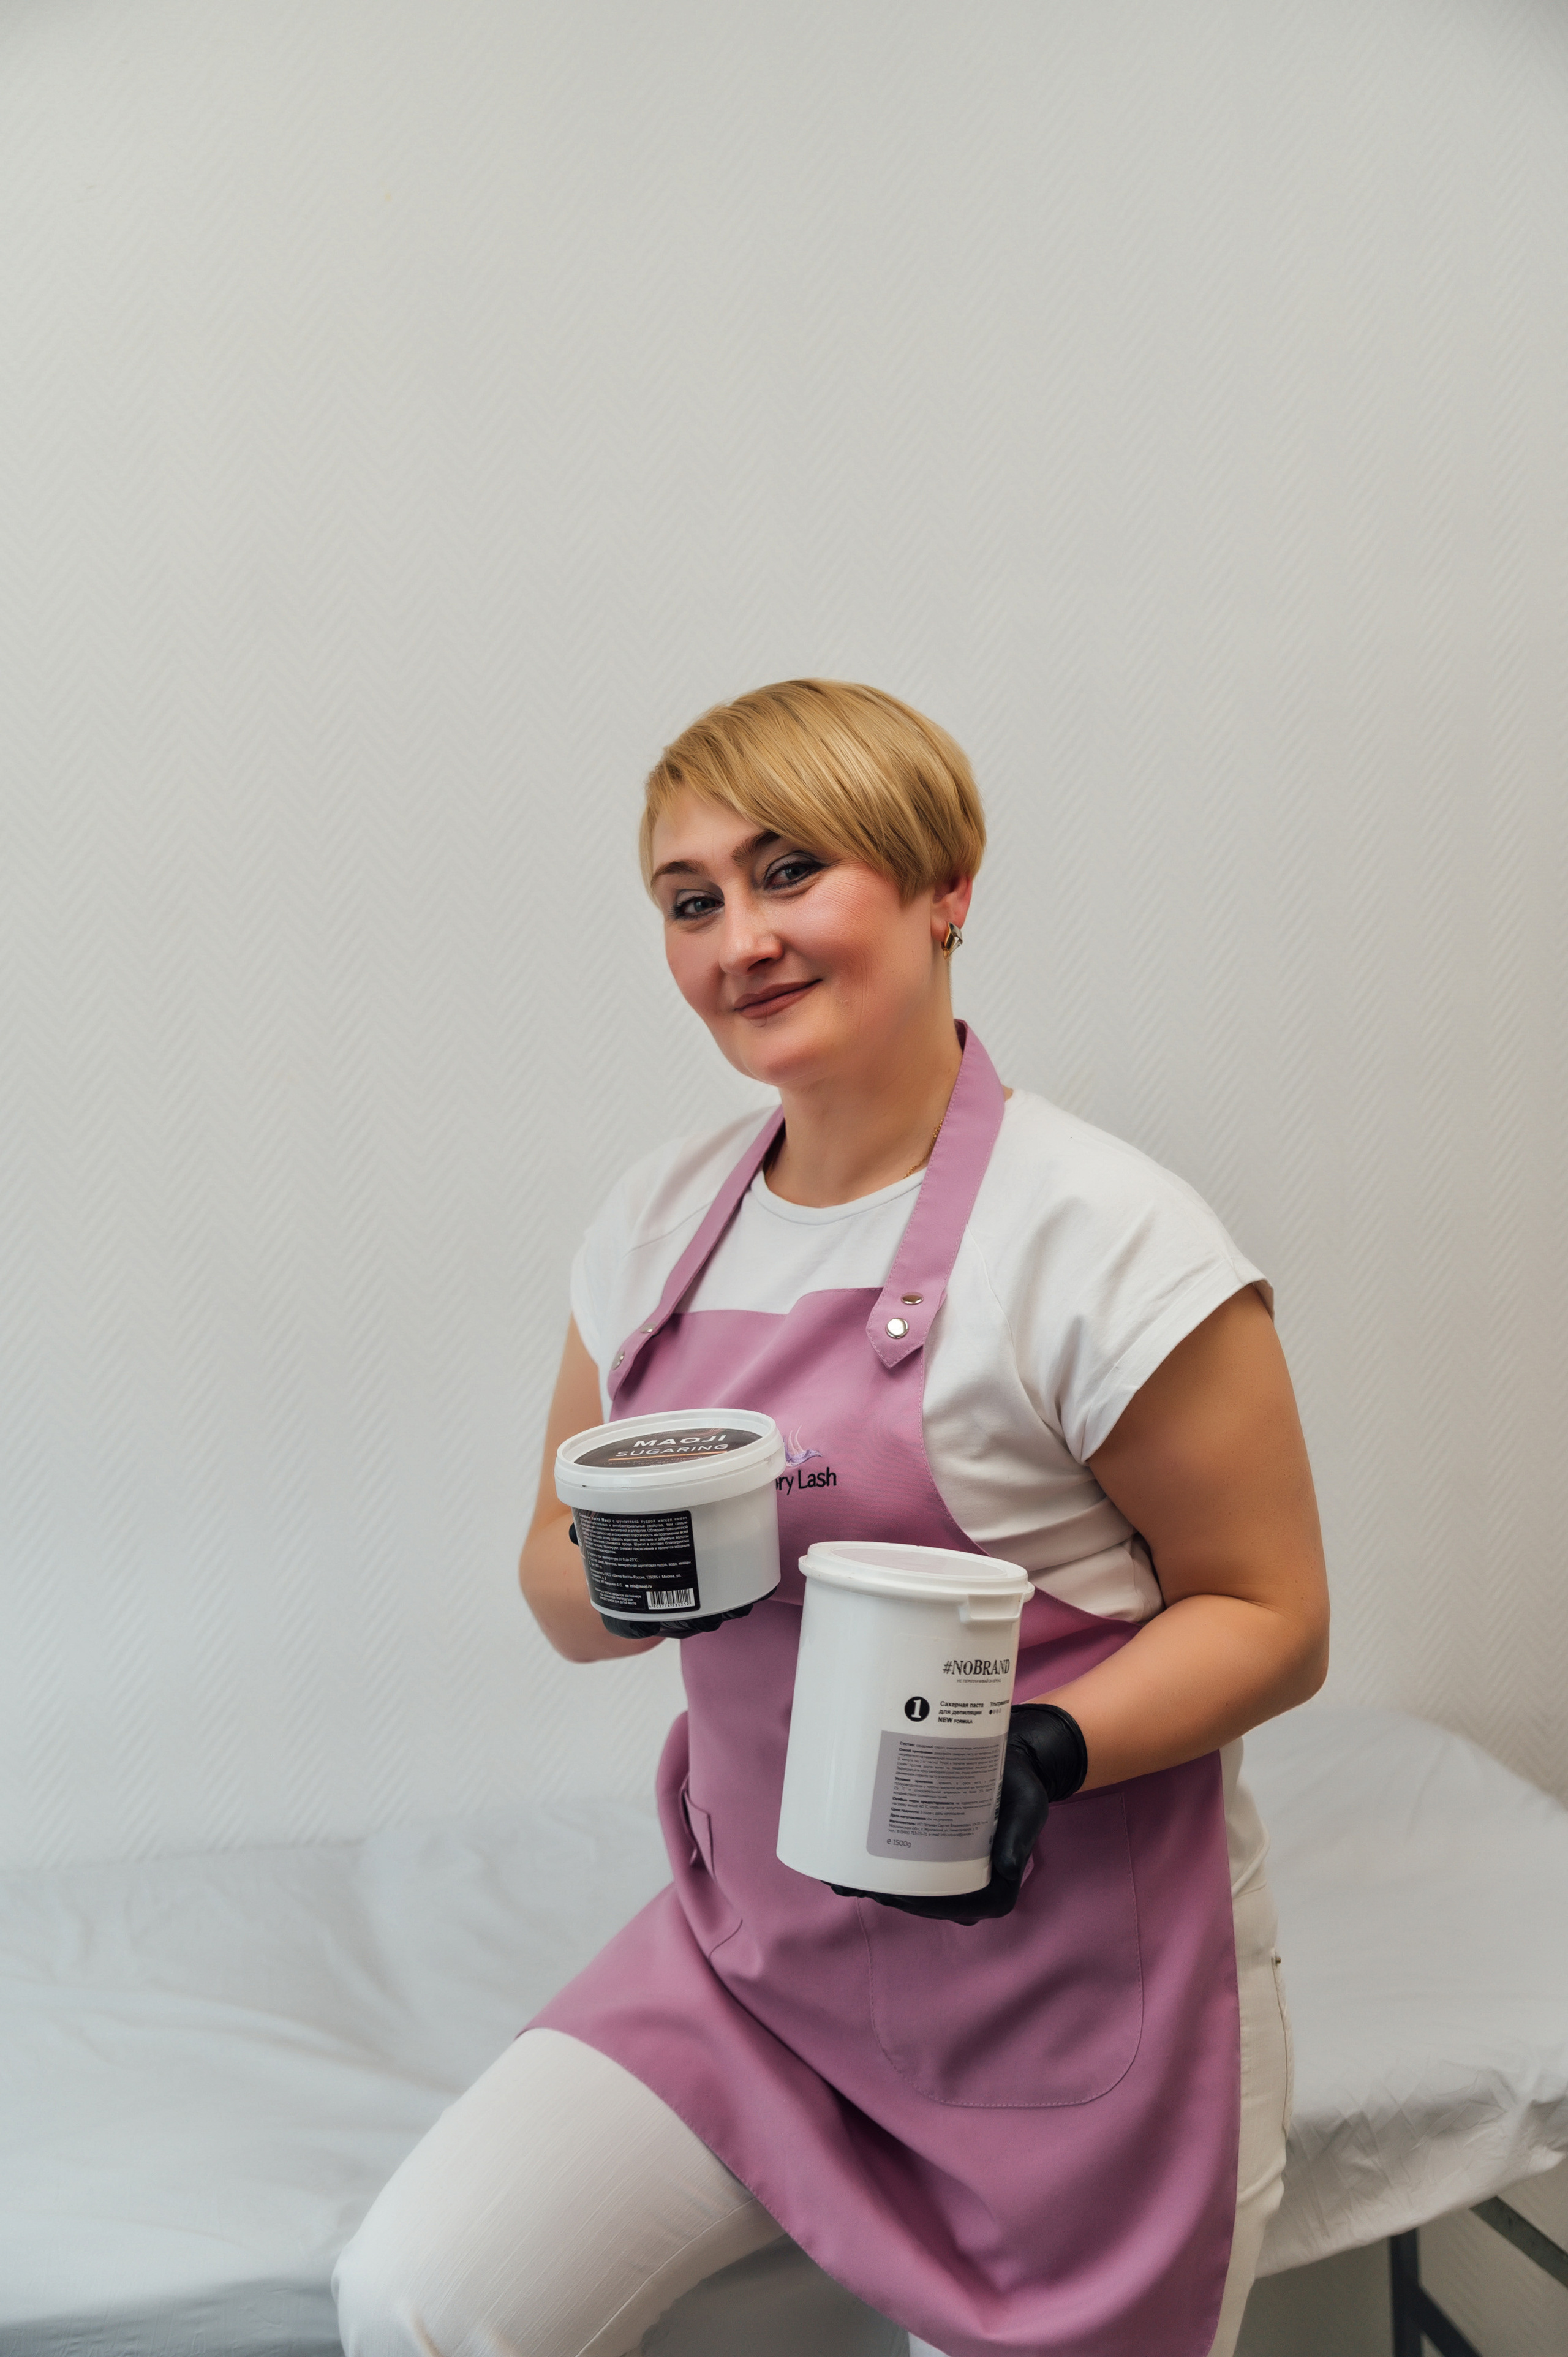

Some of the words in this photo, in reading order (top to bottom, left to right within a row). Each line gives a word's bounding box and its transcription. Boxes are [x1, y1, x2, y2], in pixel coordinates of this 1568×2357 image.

[633, 1435, 726, 1447] MAOJI
[616, 1444, 729, 1457] SUGARING
[798, 1466, 837, 1490] Lash
[911, 1699, 922, 1719] 1
[893, 1839, 911, 1849] 1500g
